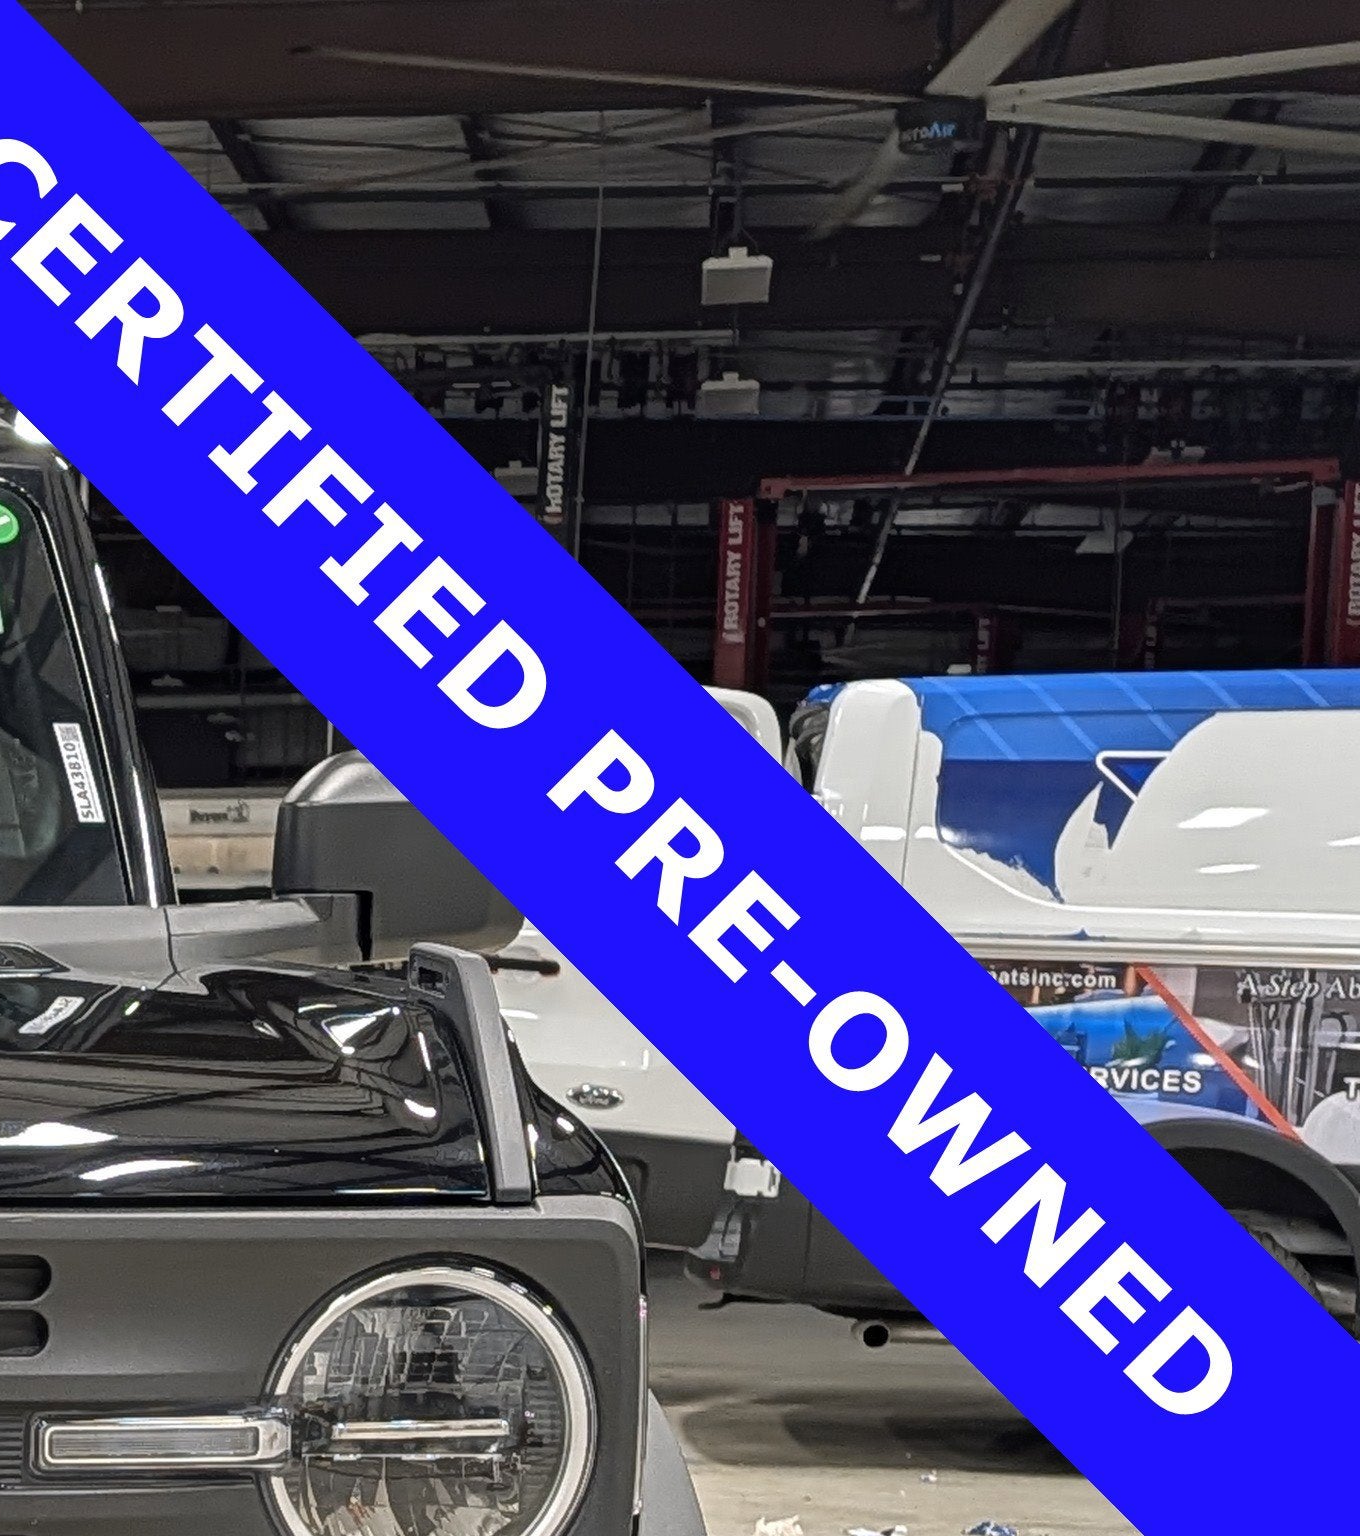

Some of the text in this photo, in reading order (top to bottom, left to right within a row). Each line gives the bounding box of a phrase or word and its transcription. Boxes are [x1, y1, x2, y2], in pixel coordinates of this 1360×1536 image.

[549, 384, 569, 428] LIFT
[723, 502, 745, 630] ROTARY LIFT
[1259, 973, 1321, 1003] Step
